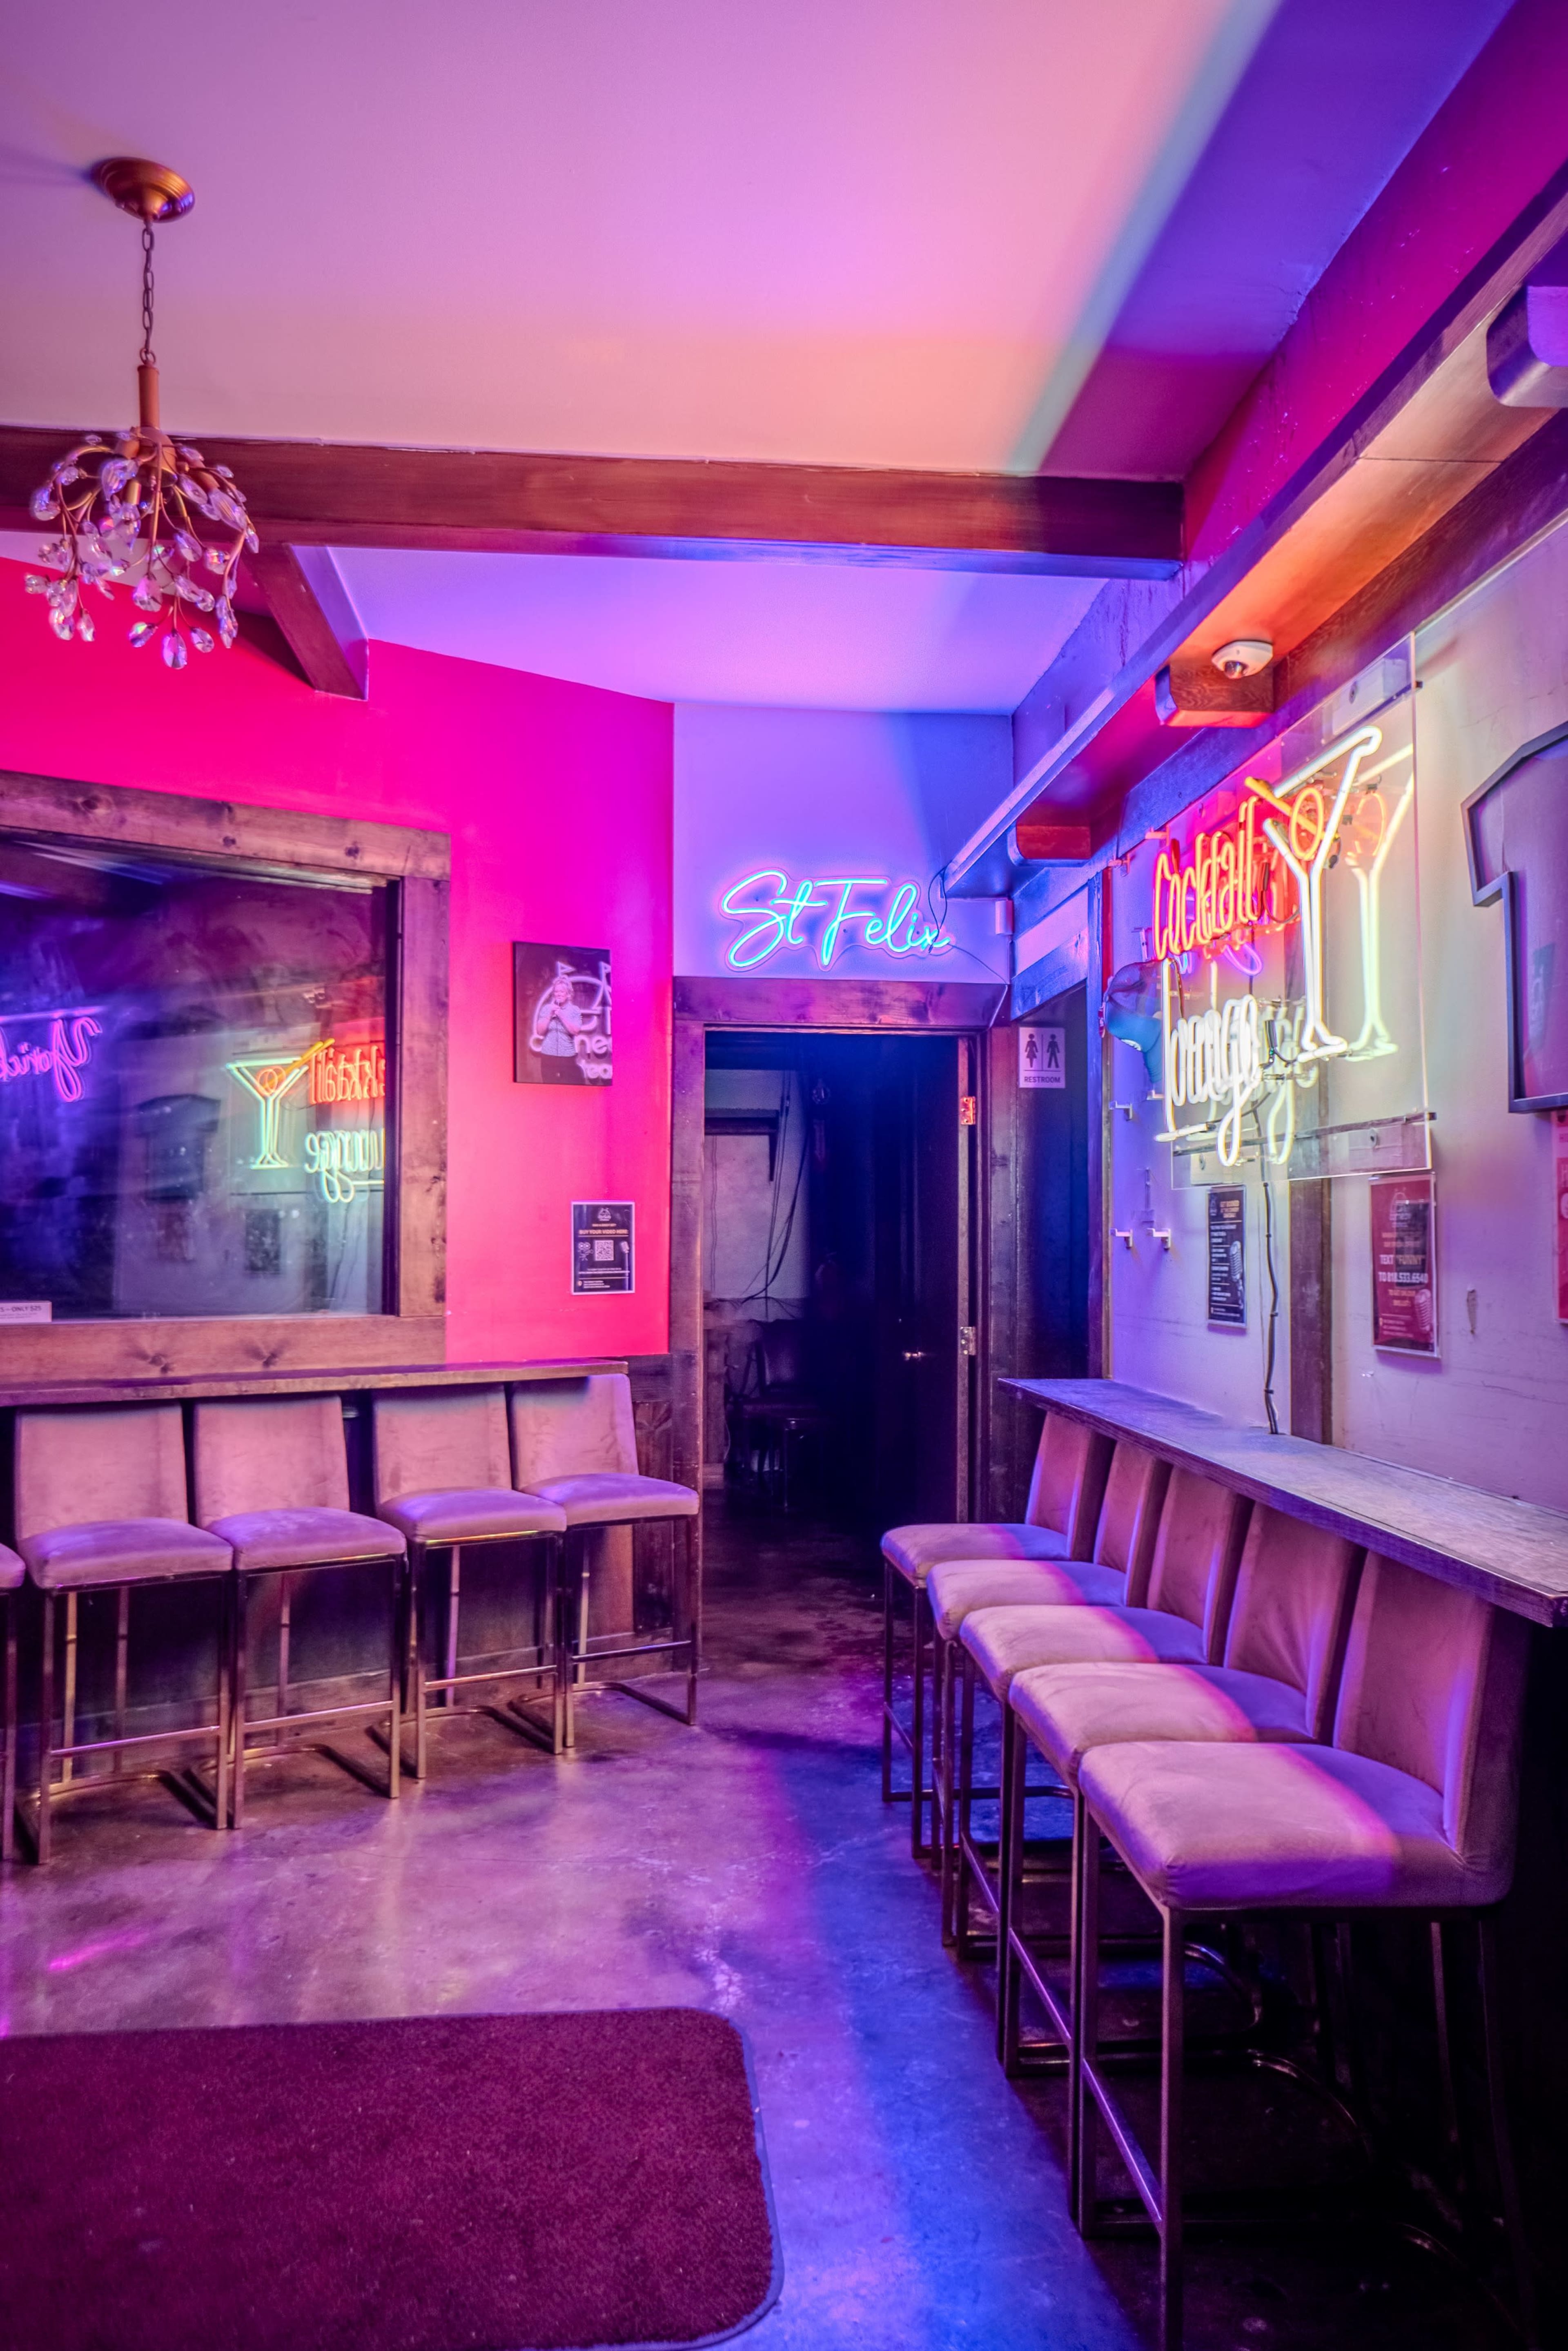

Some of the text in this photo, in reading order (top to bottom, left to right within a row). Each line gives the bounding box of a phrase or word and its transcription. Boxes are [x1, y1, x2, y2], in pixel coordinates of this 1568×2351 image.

[1154, 796, 1259, 960] Cocktail
[722, 870, 950, 967] St Felix
[1378, 1271, 1386, 1282] TO
[1379, 1255, 1394, 1264] TEXT
